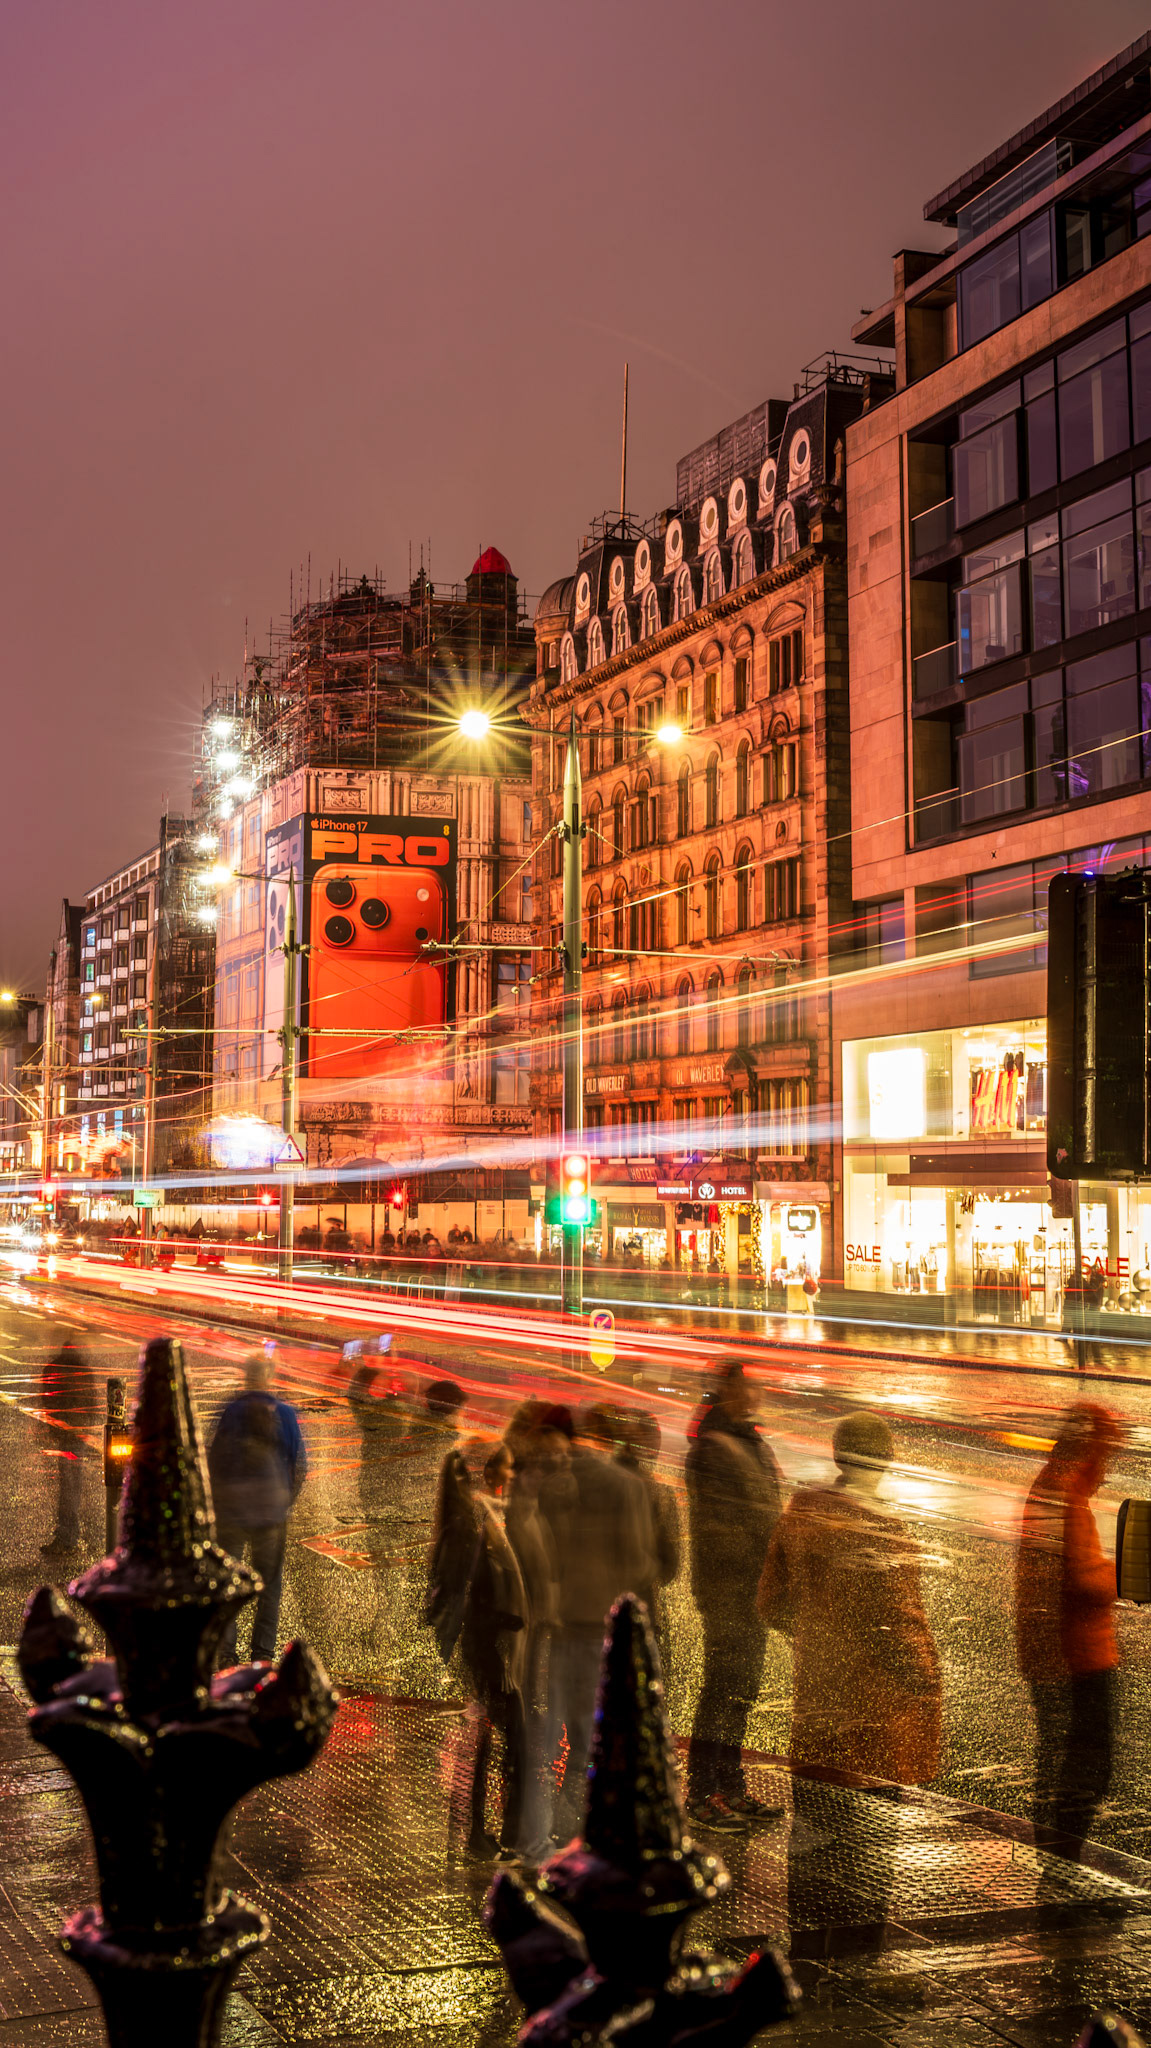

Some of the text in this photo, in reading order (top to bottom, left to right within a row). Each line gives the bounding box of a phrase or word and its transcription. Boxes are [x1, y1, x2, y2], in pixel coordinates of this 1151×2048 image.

[320, 819, 368, 832] iPhone 17
[266, 832, 301, 877] PRO
[311, 830, 450, 867] PRO
[690, 1063, 725, 1084] WAVERLEY
[586, 1075, 626, 1093] OLD WAVERLEY
[721, 1186, 747, 1195] HOTEL
[846, 1244, 881, 1263] SALE
[871, 1265, 881, 1273] OFF
[1081, 1255, 1130, 1278] SALE
[1116, 1280, 1129, 1290] OFF
